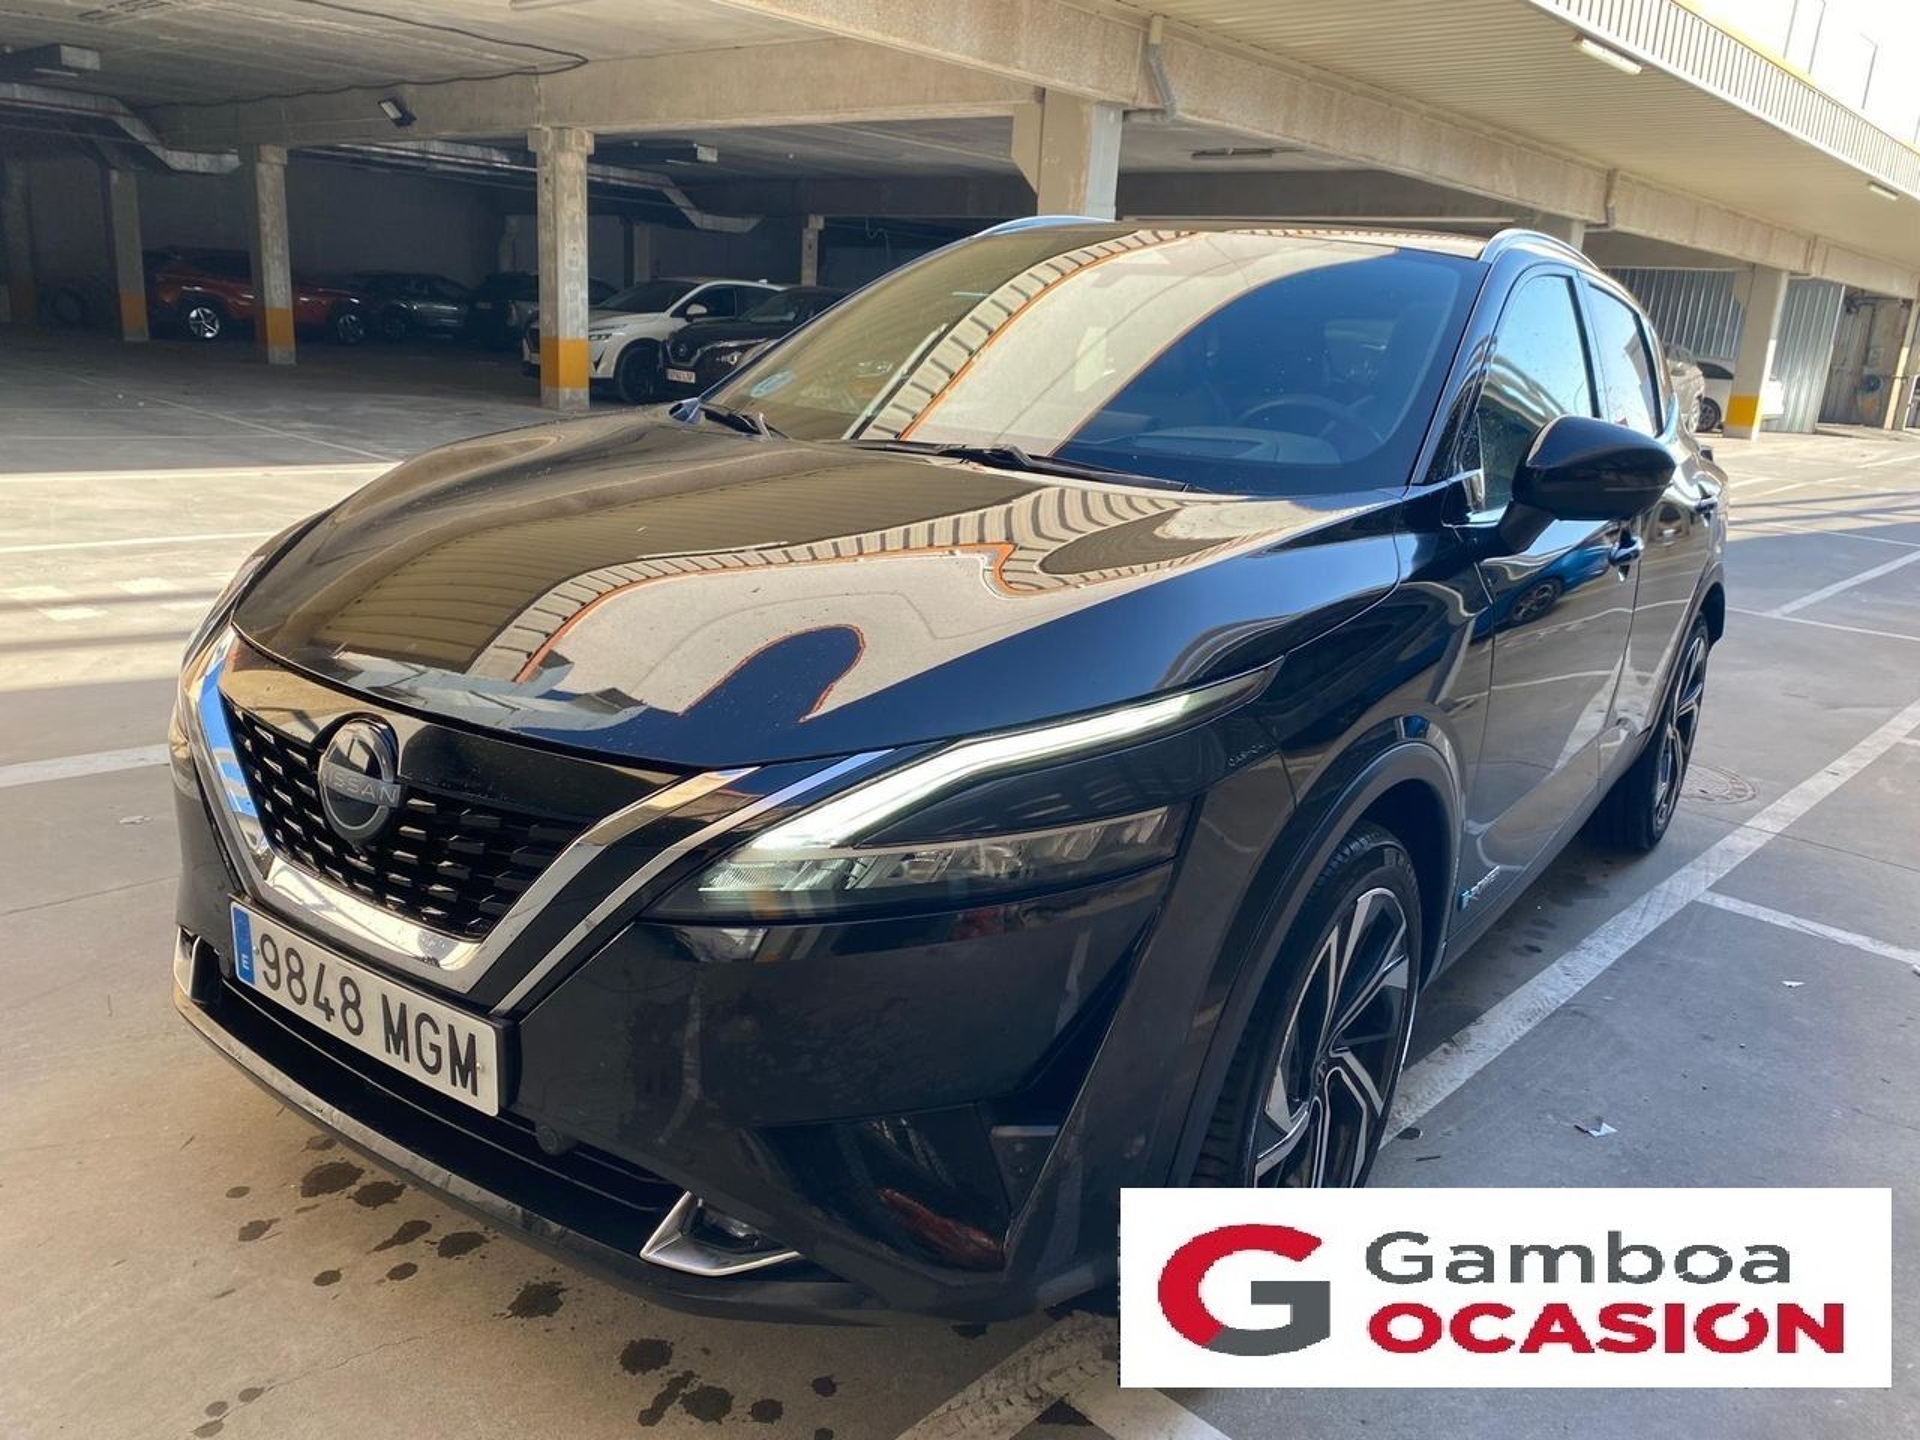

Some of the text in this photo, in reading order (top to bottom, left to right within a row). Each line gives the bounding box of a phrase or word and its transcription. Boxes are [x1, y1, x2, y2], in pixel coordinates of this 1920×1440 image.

[241, 953, 250, 970] E
[260, 933, 478, 1097] 9848 MGM
